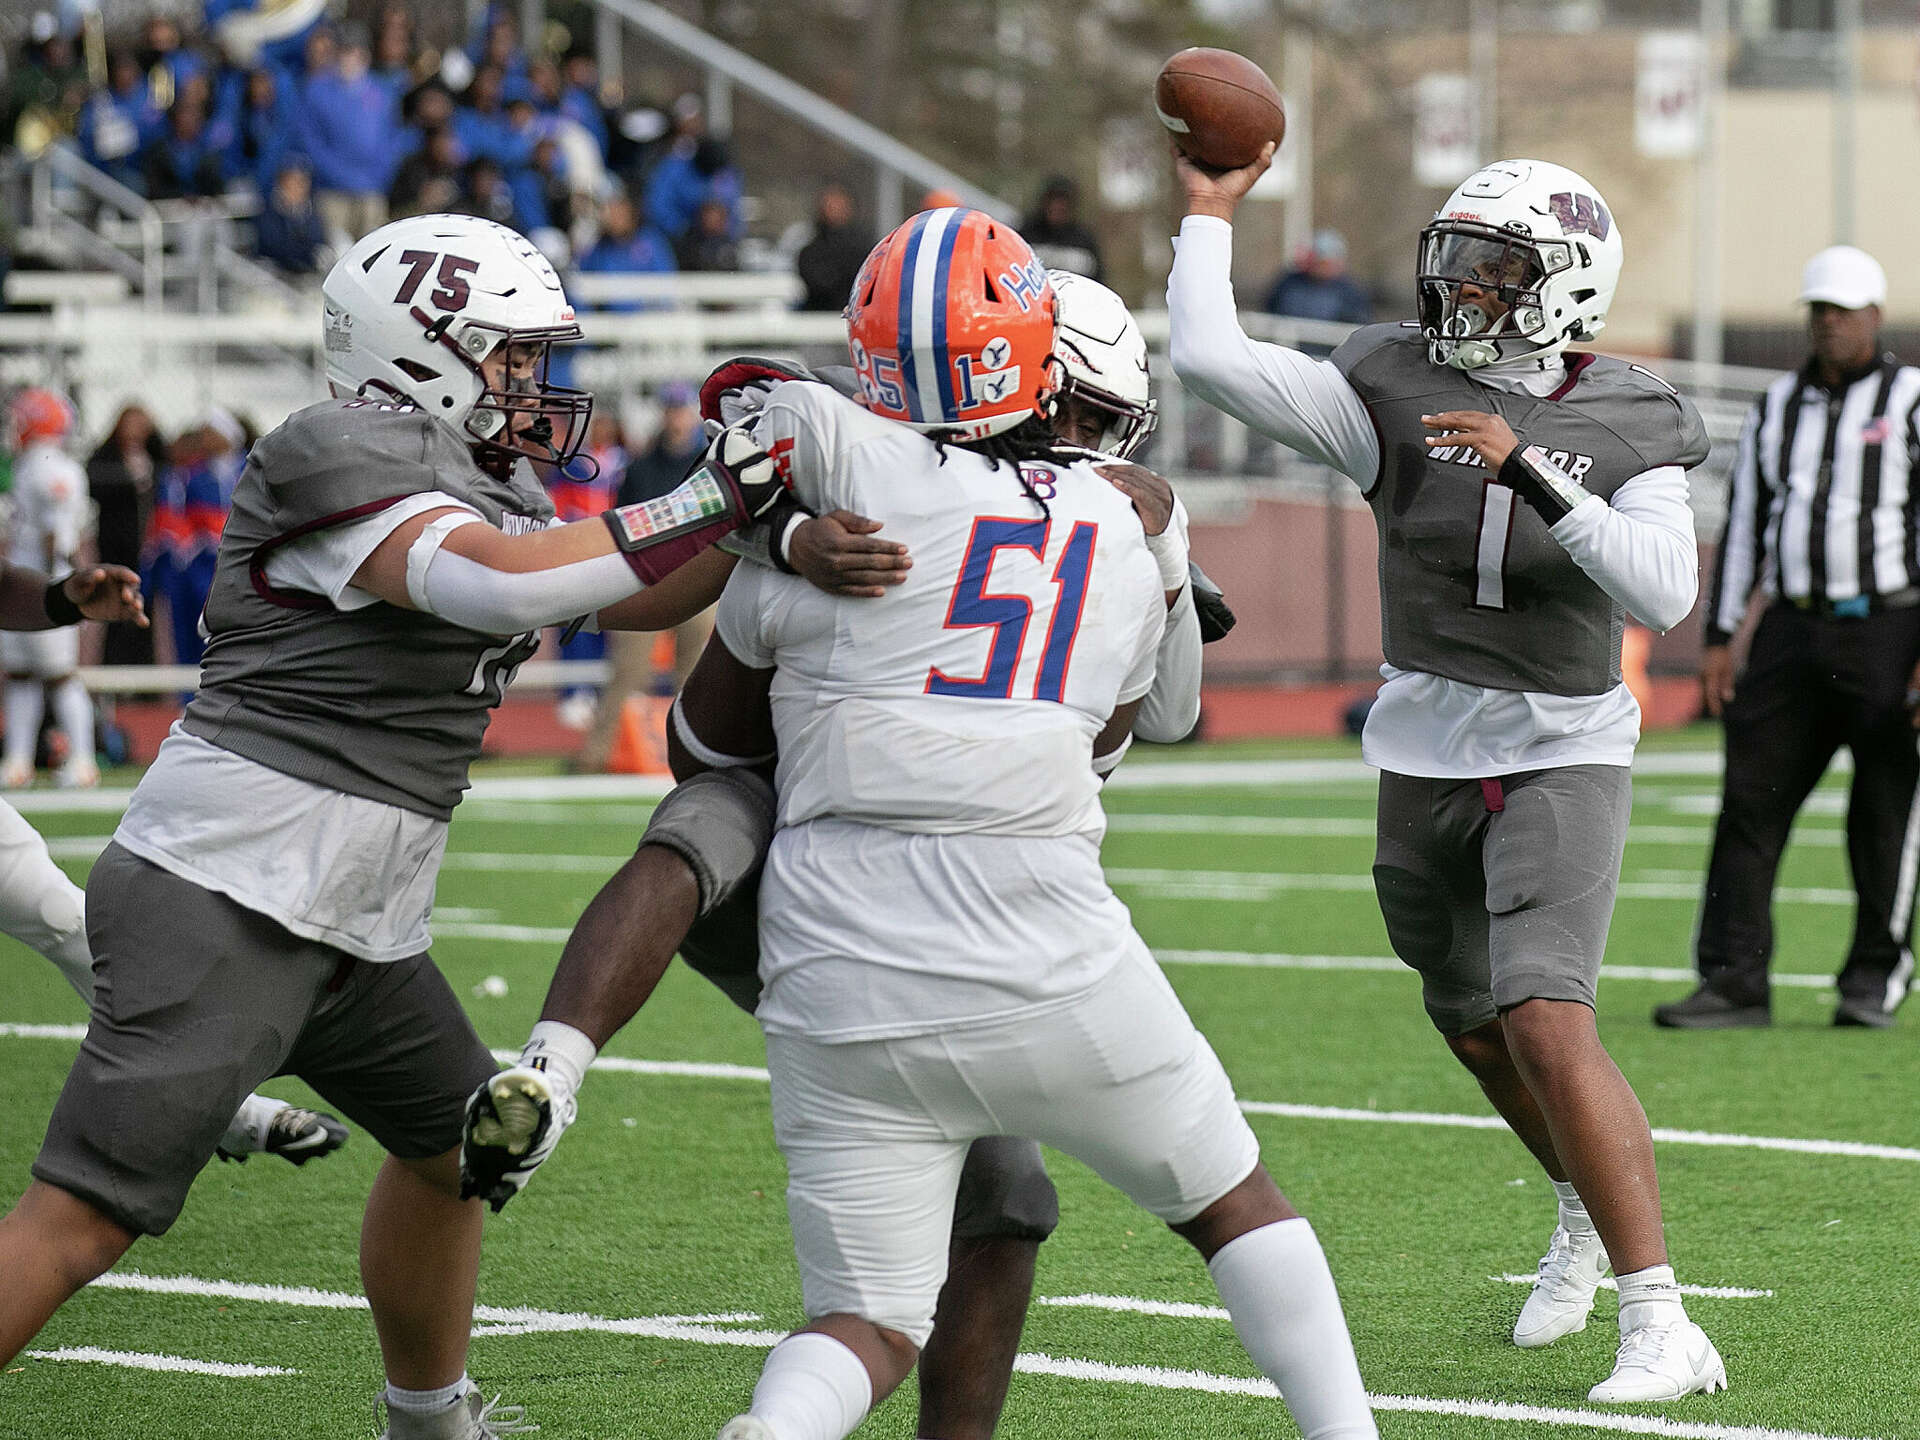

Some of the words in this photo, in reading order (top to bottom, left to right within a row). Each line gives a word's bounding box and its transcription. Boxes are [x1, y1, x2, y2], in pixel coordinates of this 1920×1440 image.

[1549, 192, 1611, 242] W
[393, 250, 481, 312] 75
[1474, 478, 1516, 609] 1
[923, 515, 1099, 703] 51
